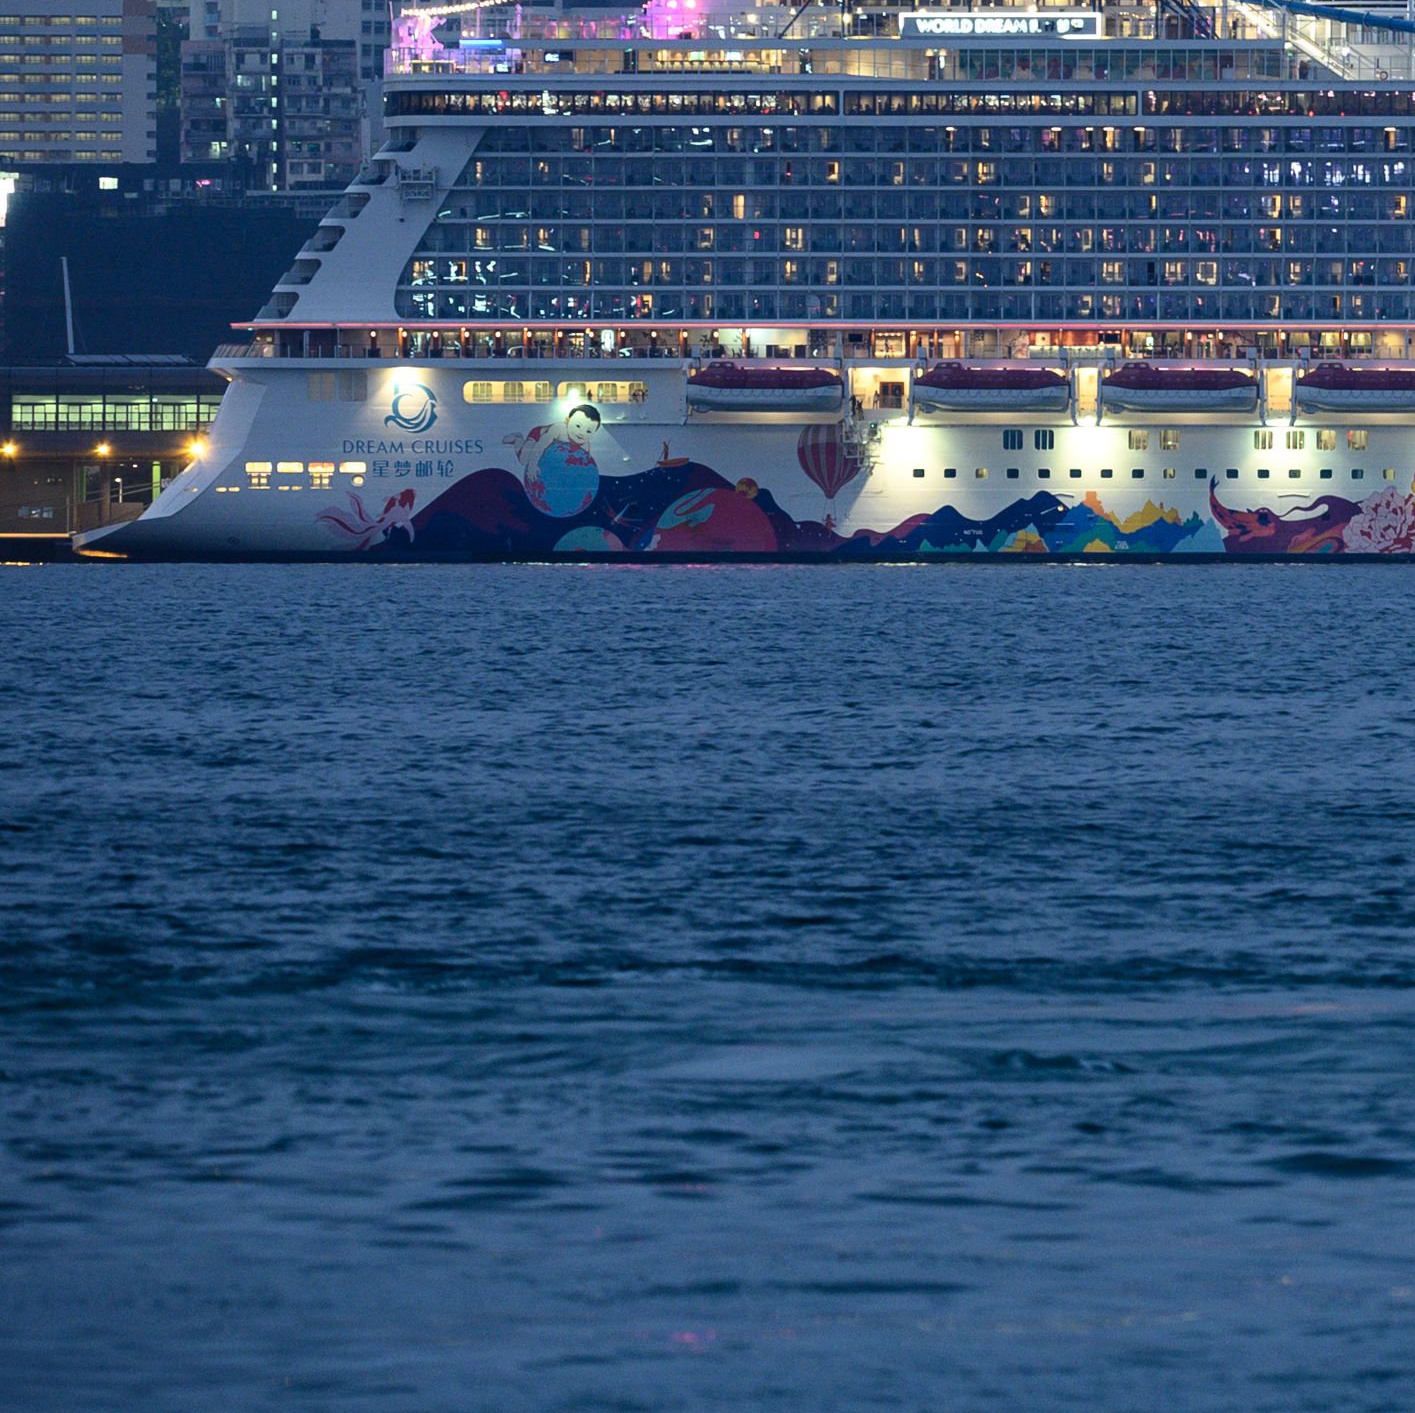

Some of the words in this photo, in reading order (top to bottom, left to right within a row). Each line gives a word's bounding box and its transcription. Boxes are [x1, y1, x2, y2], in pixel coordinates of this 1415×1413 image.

[916, 19, 973, 34] WORLD
[974, 19, 1028, 34] DREAM
[342, 439, 404, 455] DREAM
[411, 439, 484, 455] CRUISES
[372, 459, 455, 478] 星梦邮轮
